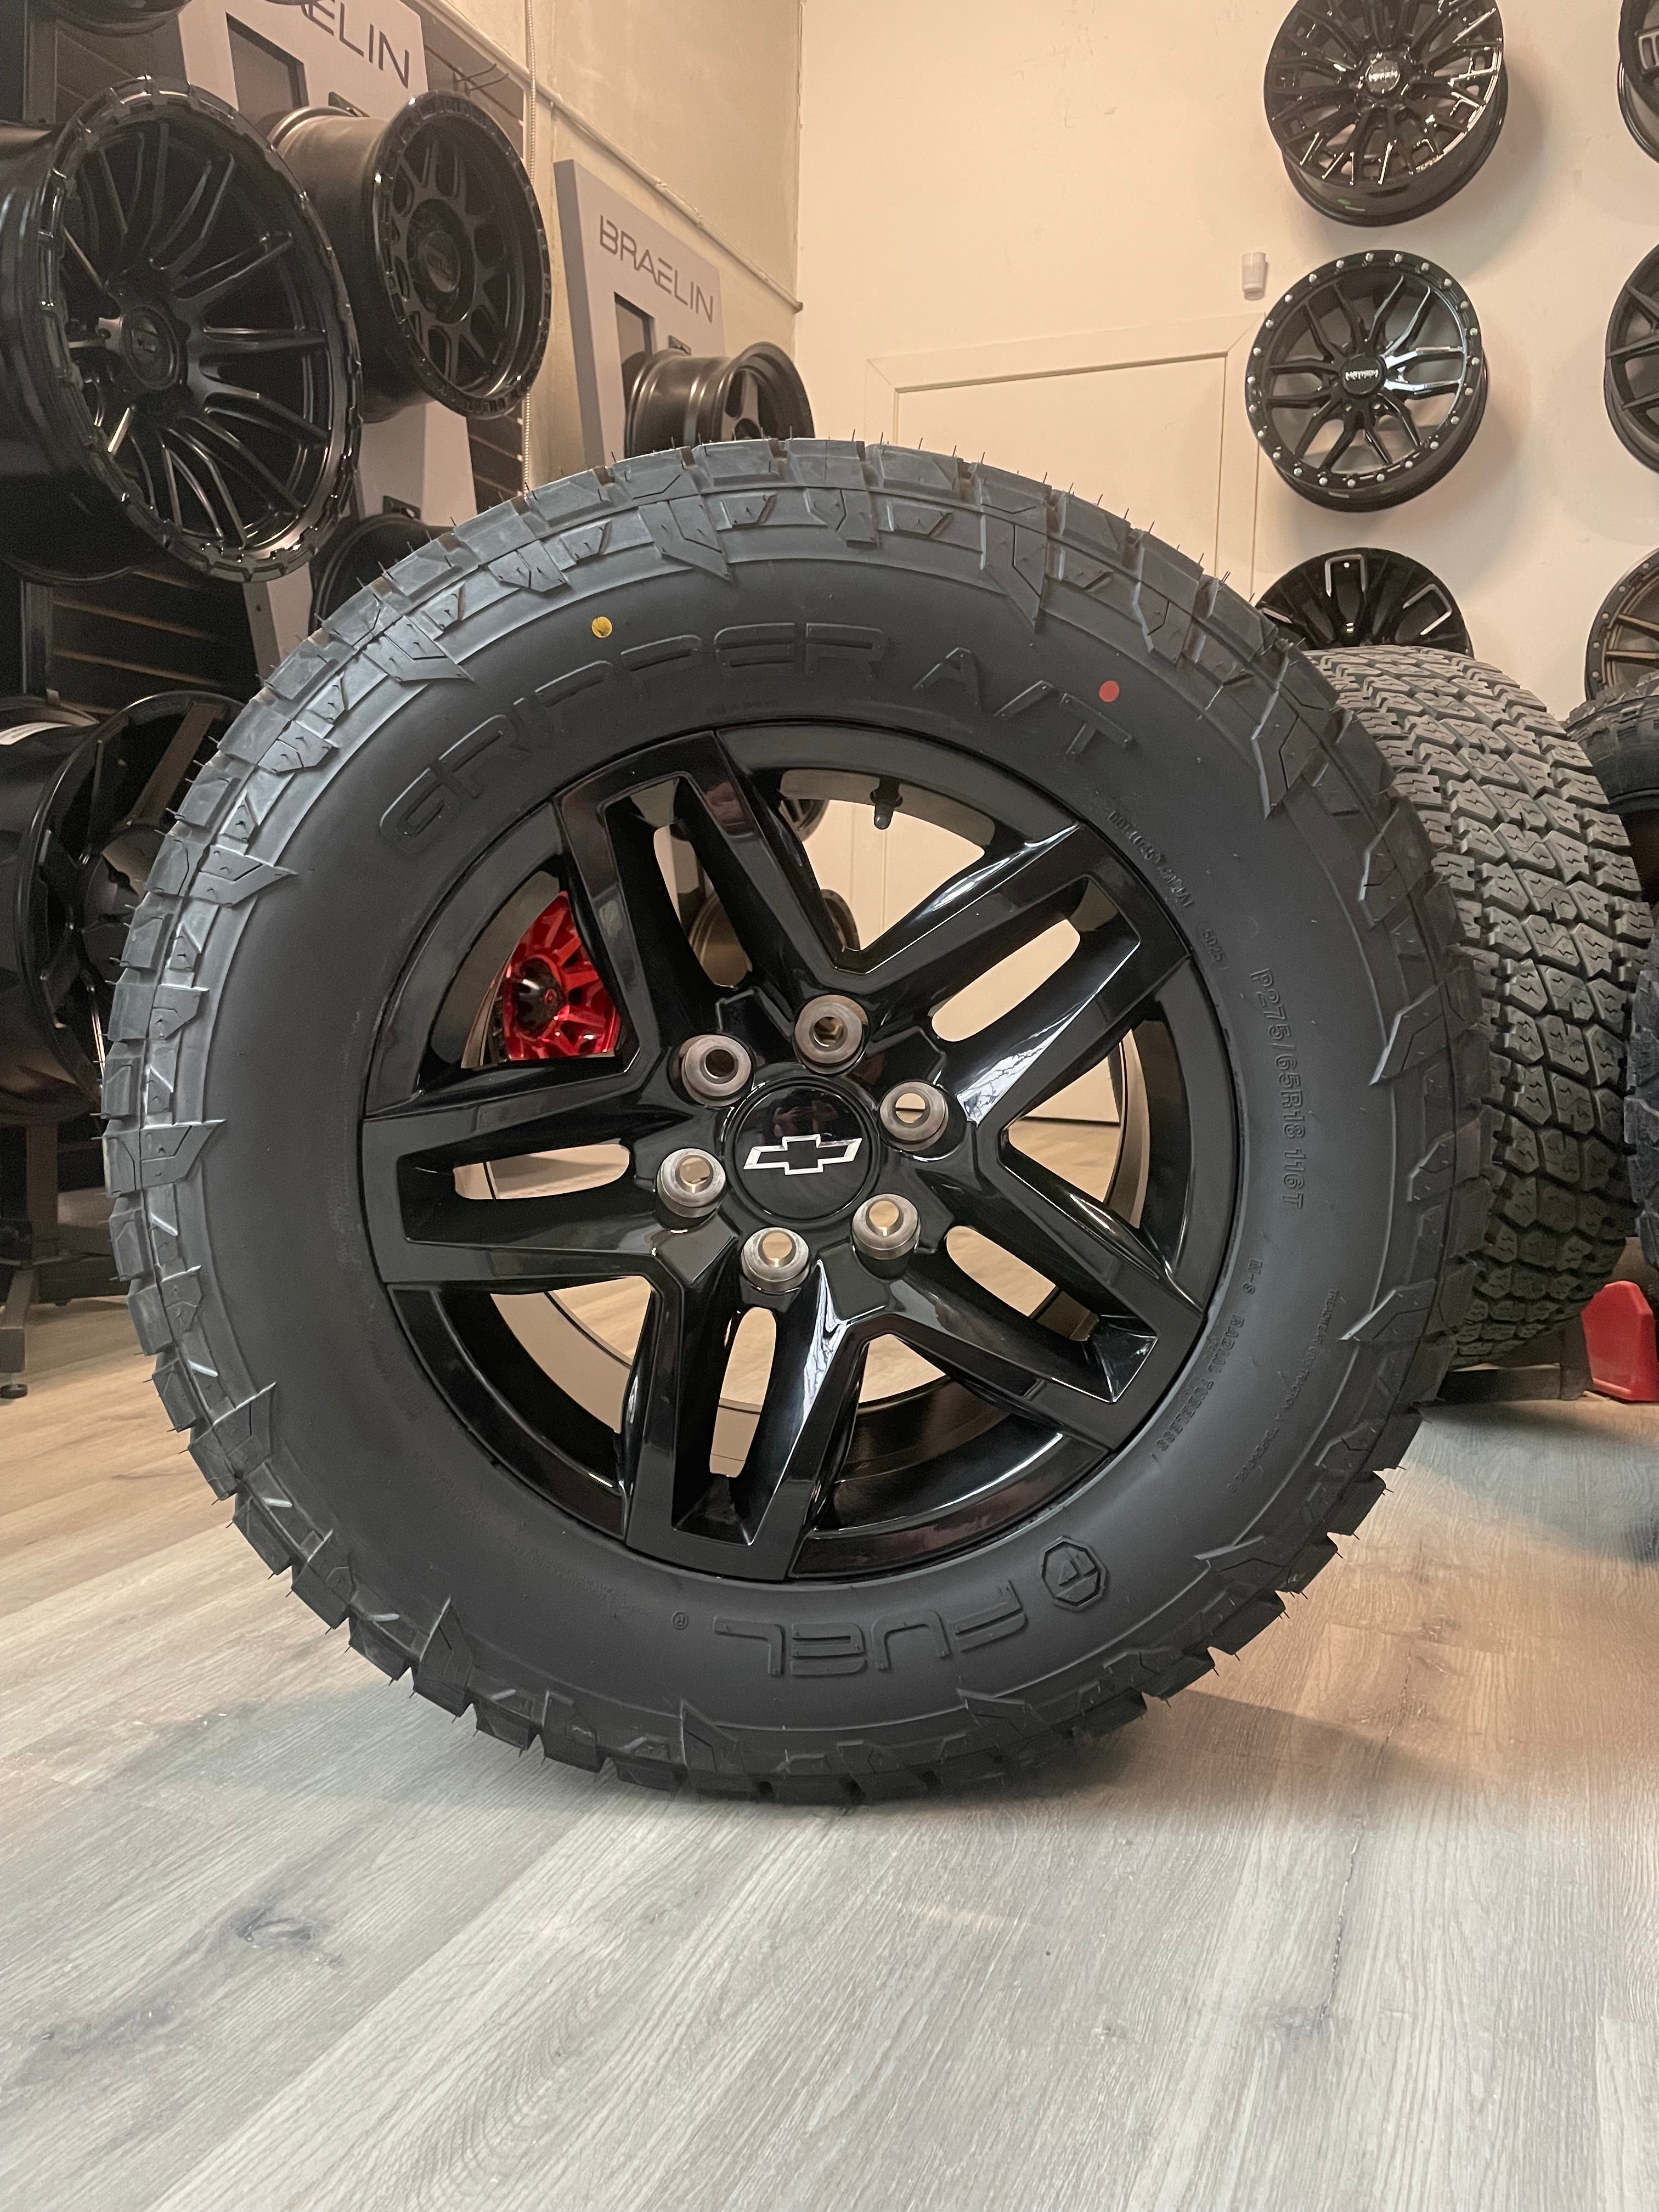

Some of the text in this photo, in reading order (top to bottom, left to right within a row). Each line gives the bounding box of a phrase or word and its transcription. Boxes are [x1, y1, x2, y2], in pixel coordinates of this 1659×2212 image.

[301, 0, 410, 89] ELIN
[600, 215, 713, 324] BRAELIN
[379, 622, 888, 855] GRIPPER
[1250, 967, 1305, 1208] P275/65R18 116T
[1207, 1314, 1245, 1373] RADIAL
[1156, 1378, 1215, 1452] TUBELESS
[714, 1579, 1029, 1679] FUEL
